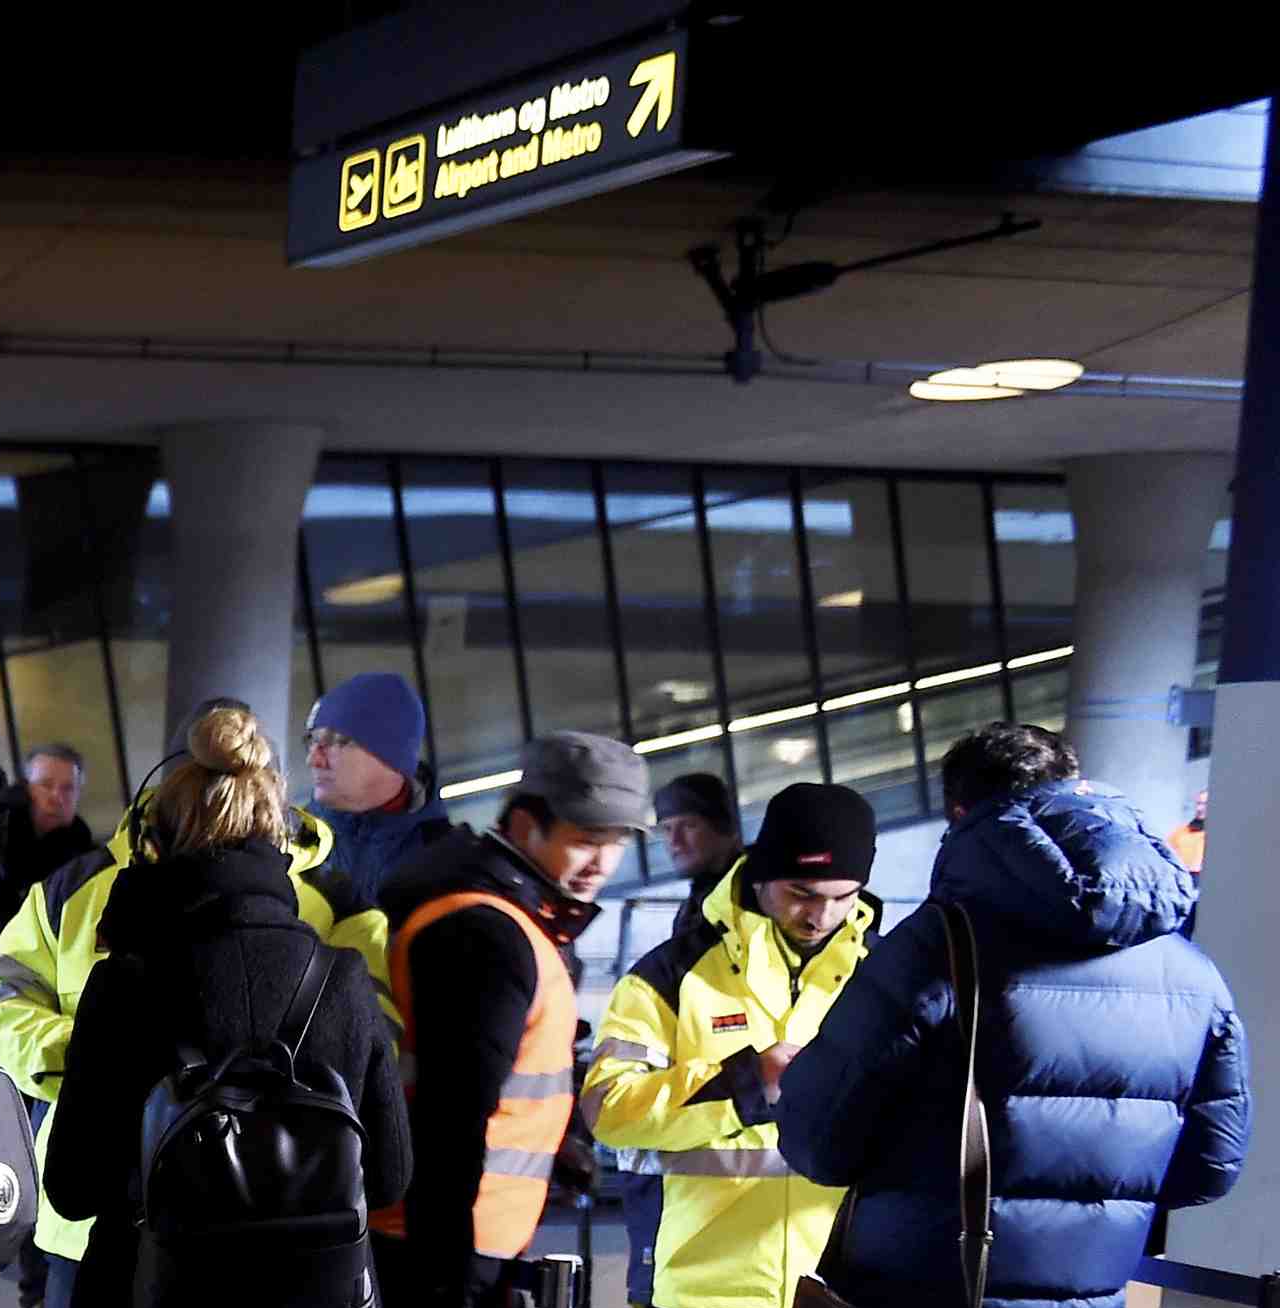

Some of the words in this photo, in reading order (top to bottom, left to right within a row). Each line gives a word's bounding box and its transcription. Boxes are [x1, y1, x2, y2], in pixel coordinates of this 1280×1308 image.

[436, 106, 517, 158] Lufthavn
[518, 97, 546, 134] og
[549, 75, 610, 121] Metro
[434, 149, 499, 199] Airport
[499, 134, 540, 179] and
[541, 121, 602, 166] Metro
